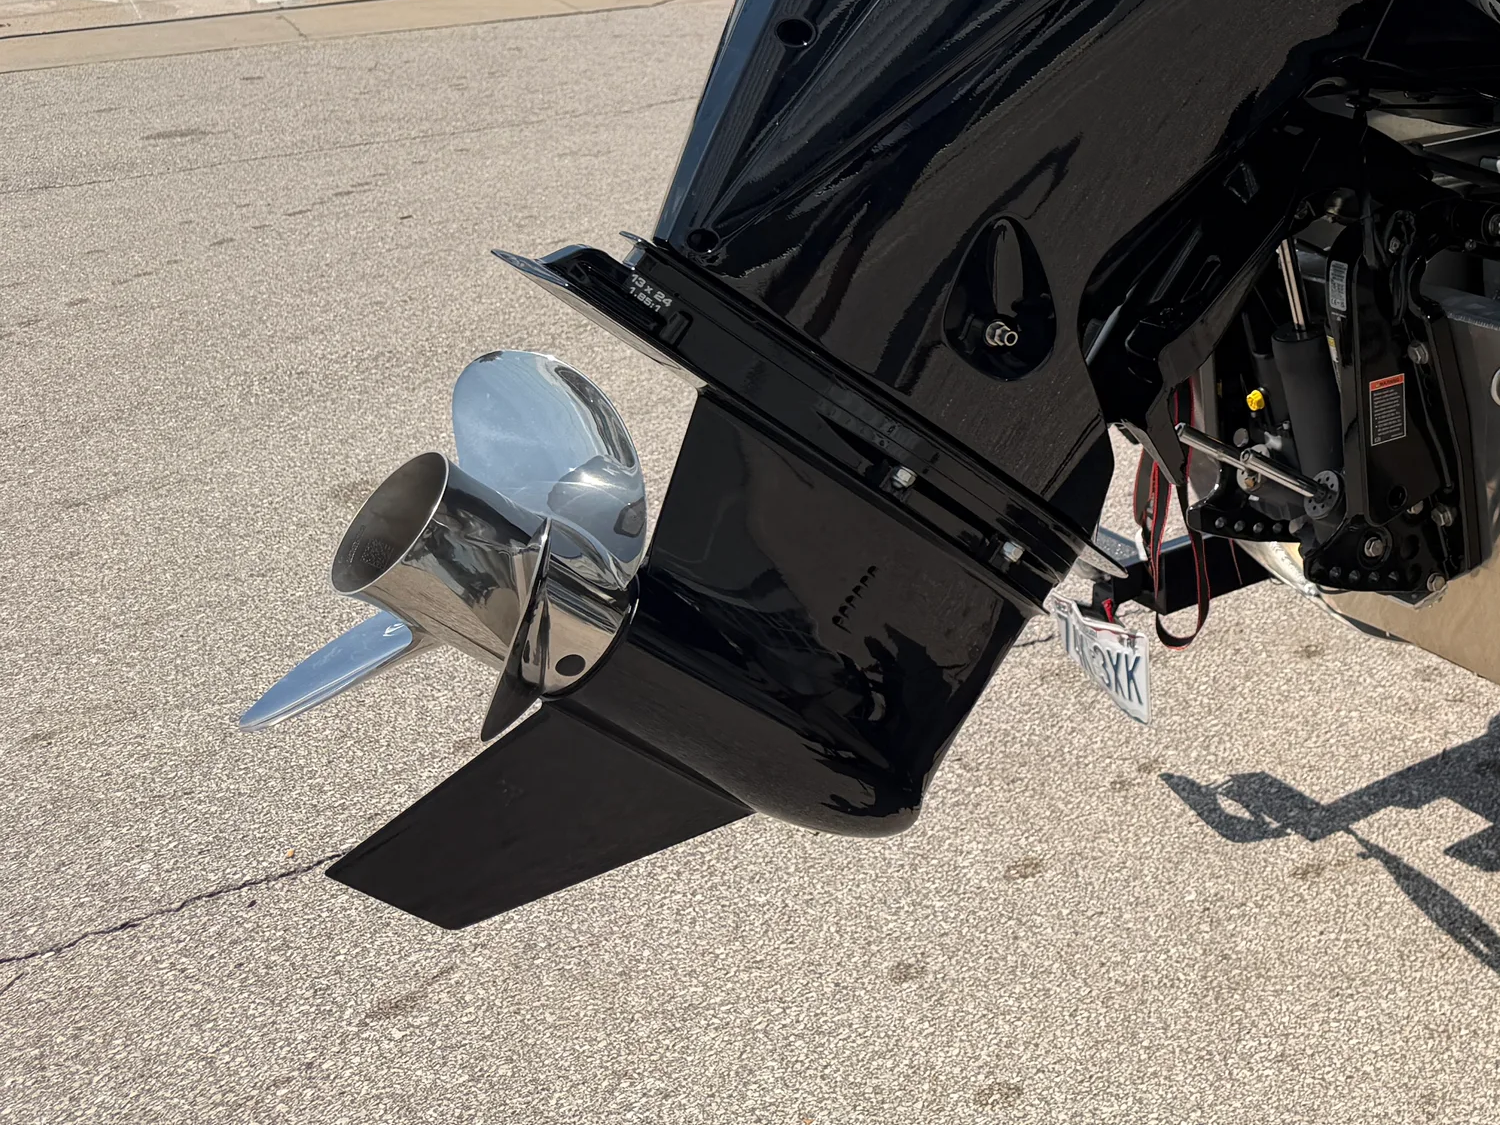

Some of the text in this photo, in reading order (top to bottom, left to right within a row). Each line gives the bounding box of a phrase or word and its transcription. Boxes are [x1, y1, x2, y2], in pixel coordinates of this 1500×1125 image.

[629, 286, 662, 313] 1.85:1
[631, 273, 646, 288] 13
[653, 290, 673, 307] 24
